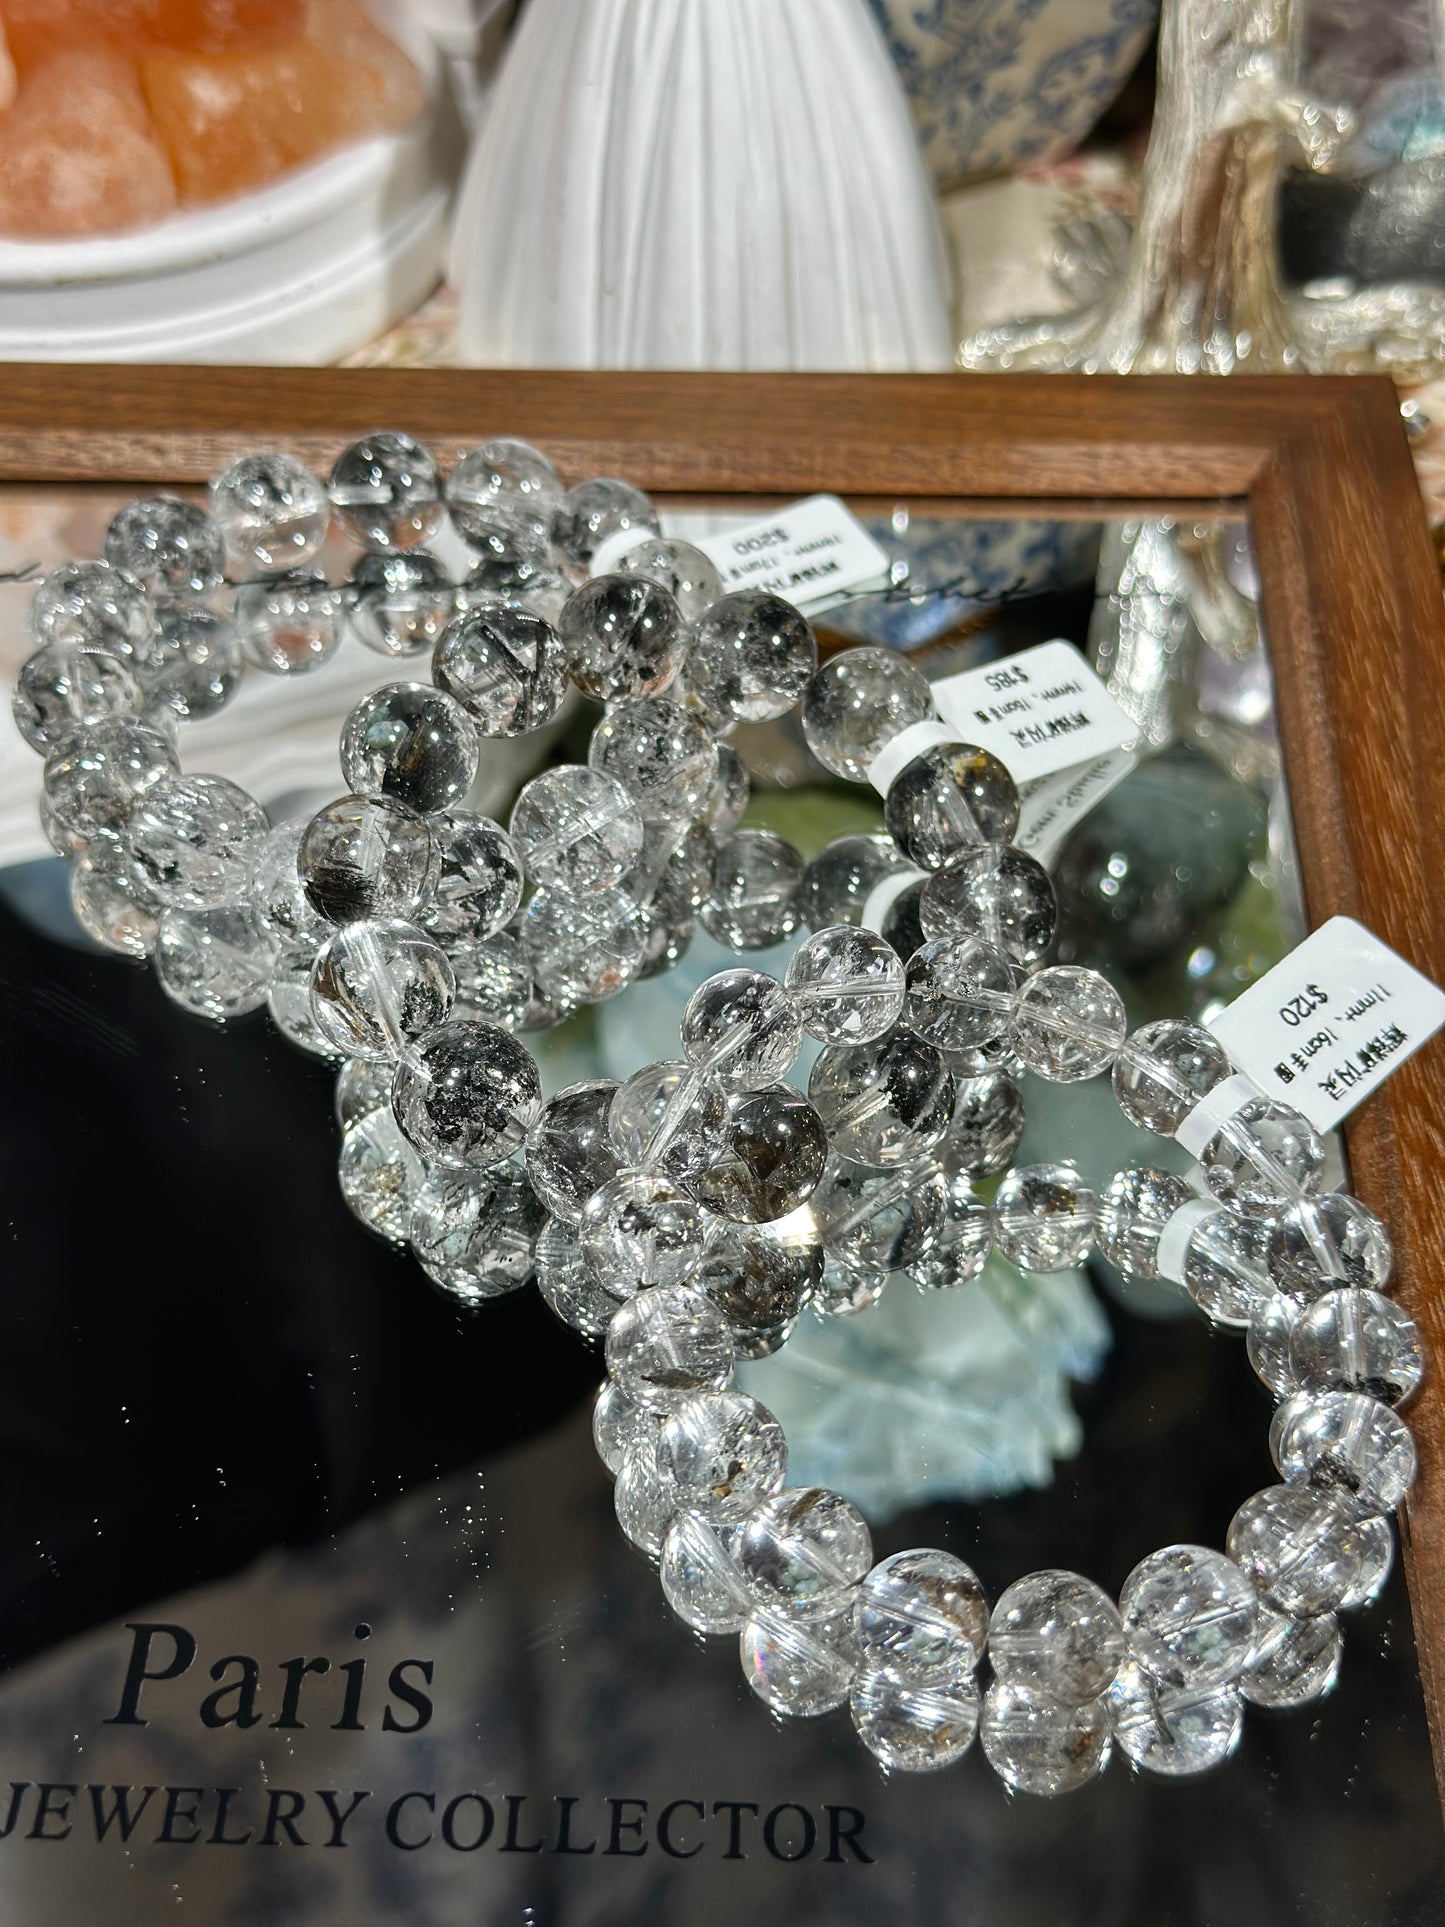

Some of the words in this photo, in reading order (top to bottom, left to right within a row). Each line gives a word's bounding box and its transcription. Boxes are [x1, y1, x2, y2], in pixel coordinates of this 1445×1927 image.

[733, 528, 789, 555] $200
[984, 665, 1029, 692] $185
[1279, 983, 1329, 1027] $120
[102, 1622, 435, 1734] Paris
[0, 1781, 374, 1848] JEWELRY
[385, 1791, 878, 1864] COLLECTOR
